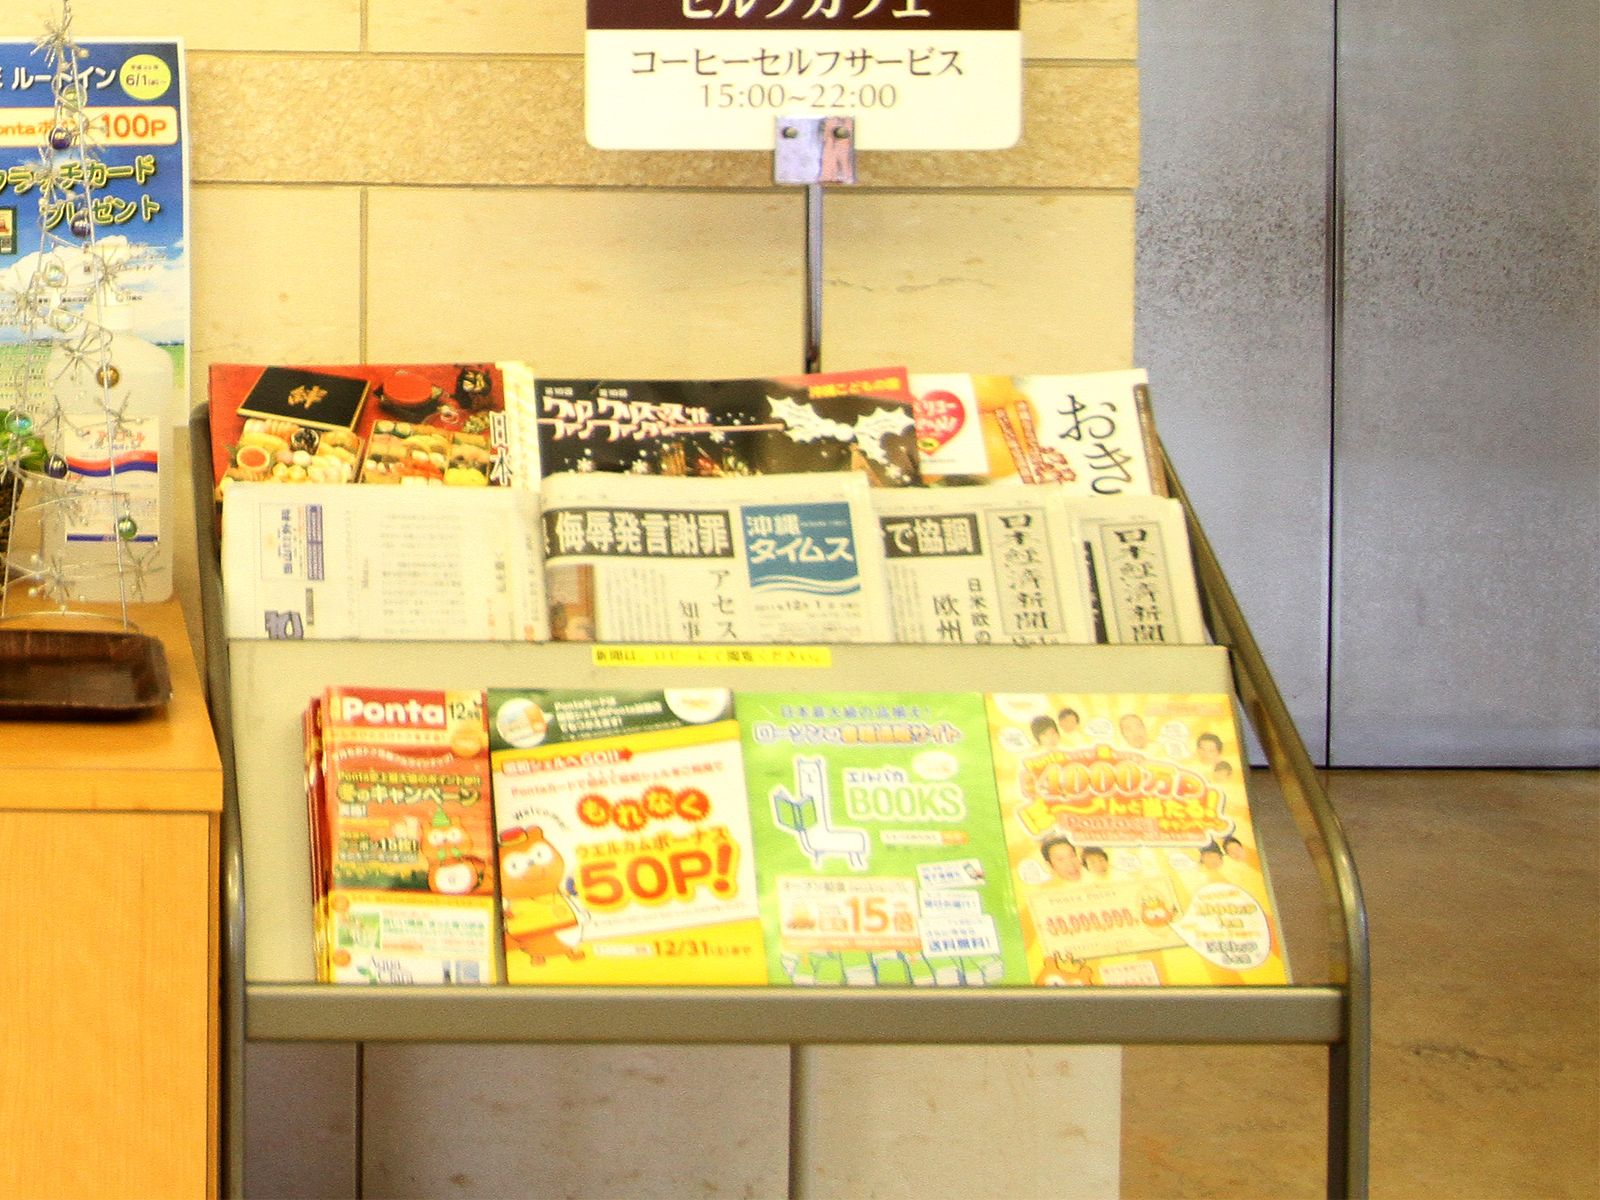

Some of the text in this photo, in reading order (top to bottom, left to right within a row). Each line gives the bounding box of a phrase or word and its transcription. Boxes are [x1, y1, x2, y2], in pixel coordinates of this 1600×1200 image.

[631, 48, 964, 77] コーヒーセルフサービス
[542, 510, 731, 556] 侮辱発言謝罪
[746, 513, 801, 536] 沖縄
[749, 536, 855, 564] タイムス
[342, 695, 447, 725] Ponta
[850, 785, 962, 817] BOOKS
[579, 843, 733, 907] 50P!
